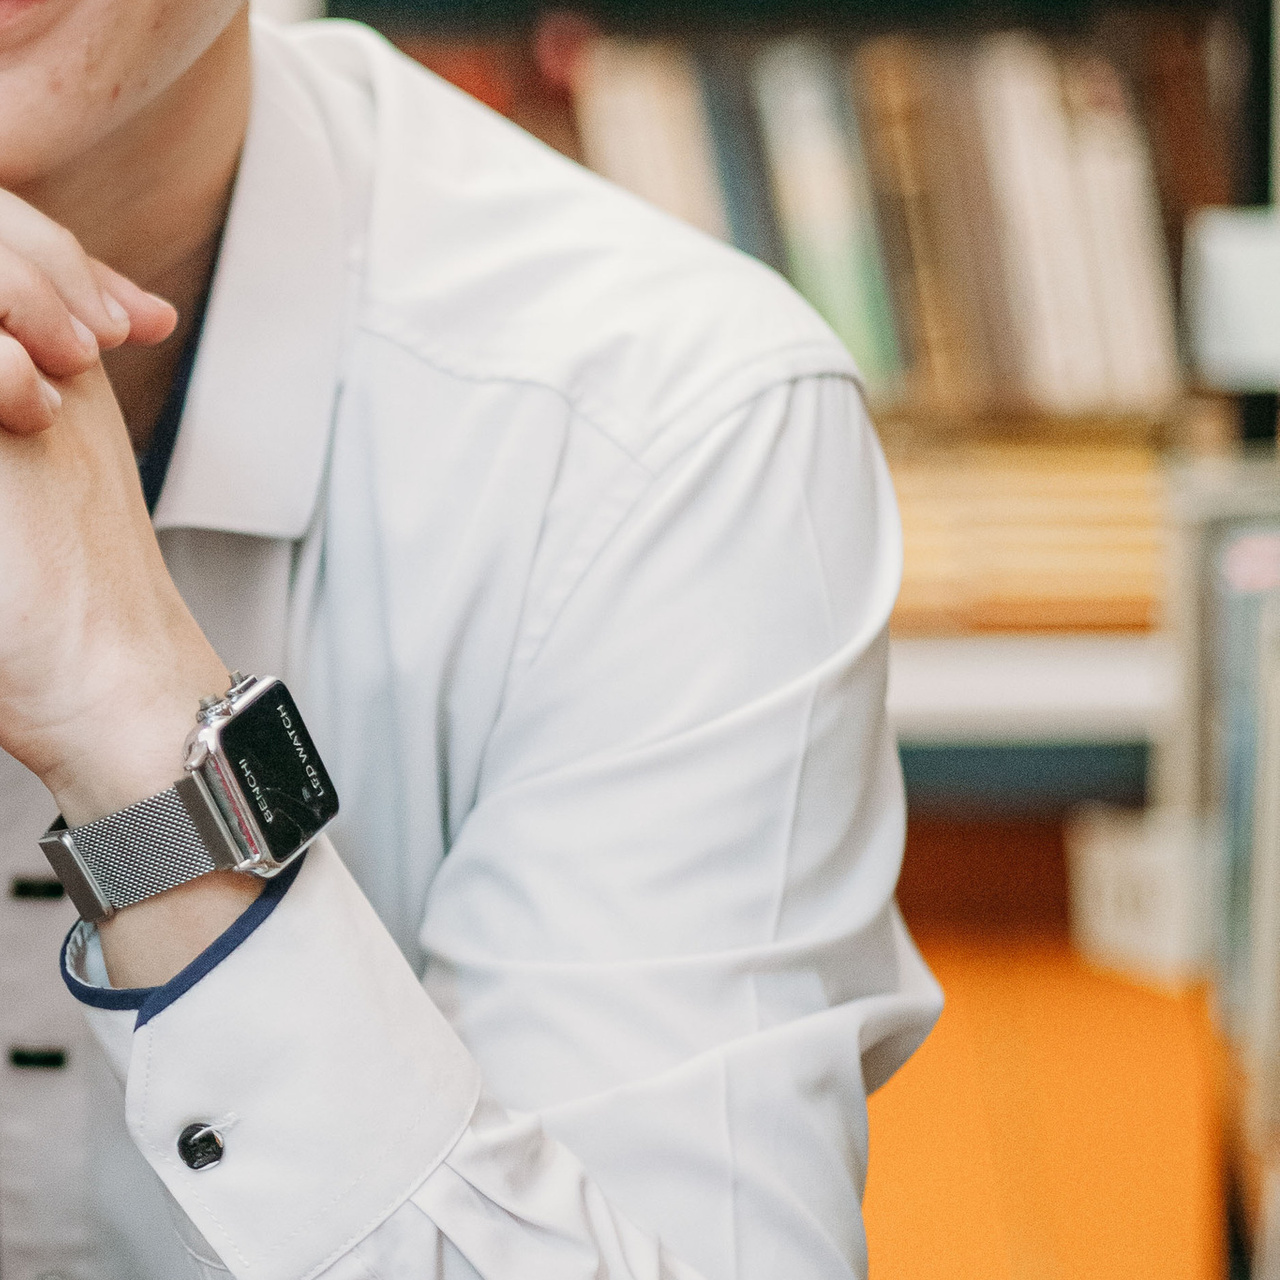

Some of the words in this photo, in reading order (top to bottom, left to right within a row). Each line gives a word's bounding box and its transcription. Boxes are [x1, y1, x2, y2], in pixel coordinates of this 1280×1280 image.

[276, 704, 307, 764] WATCH
[238, 758, 273, 824] BENCHI
[305, 765, 324, 797] LED
